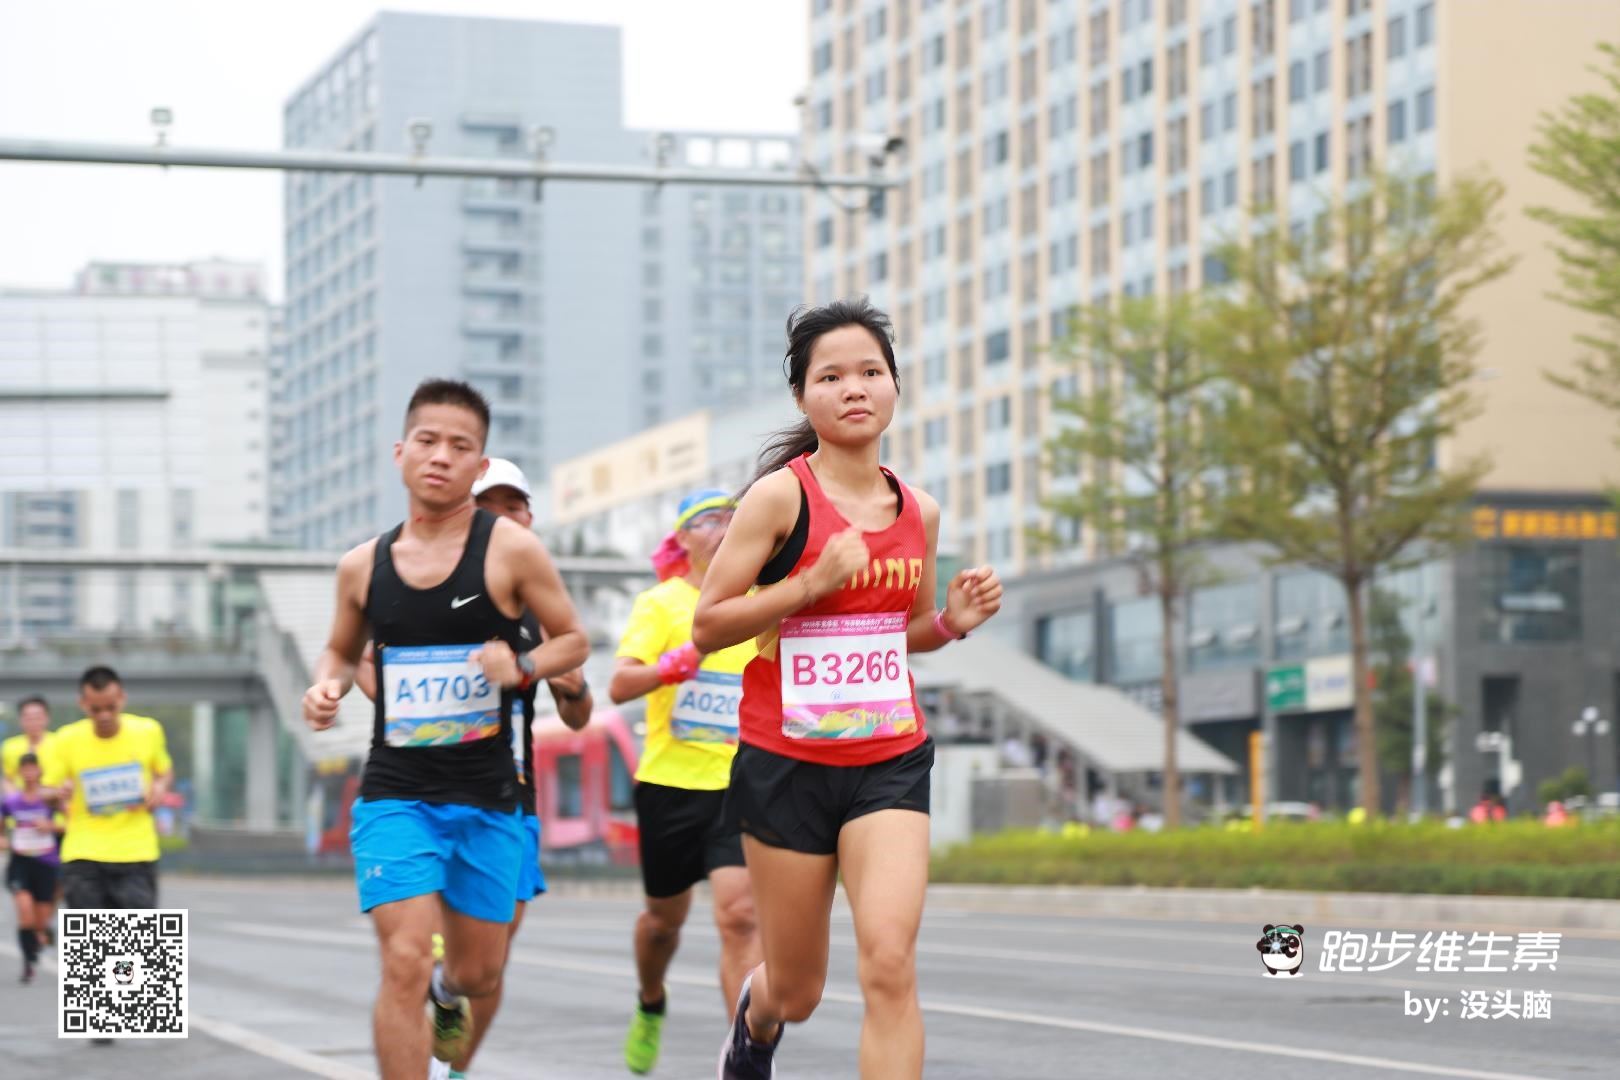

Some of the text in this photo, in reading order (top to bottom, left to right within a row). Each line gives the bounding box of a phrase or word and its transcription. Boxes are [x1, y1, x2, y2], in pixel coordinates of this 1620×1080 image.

[839, 558, 923, 590] HINA
[792, 649, 901, 686] B3266
[395, 672, 491, 703] A1703
